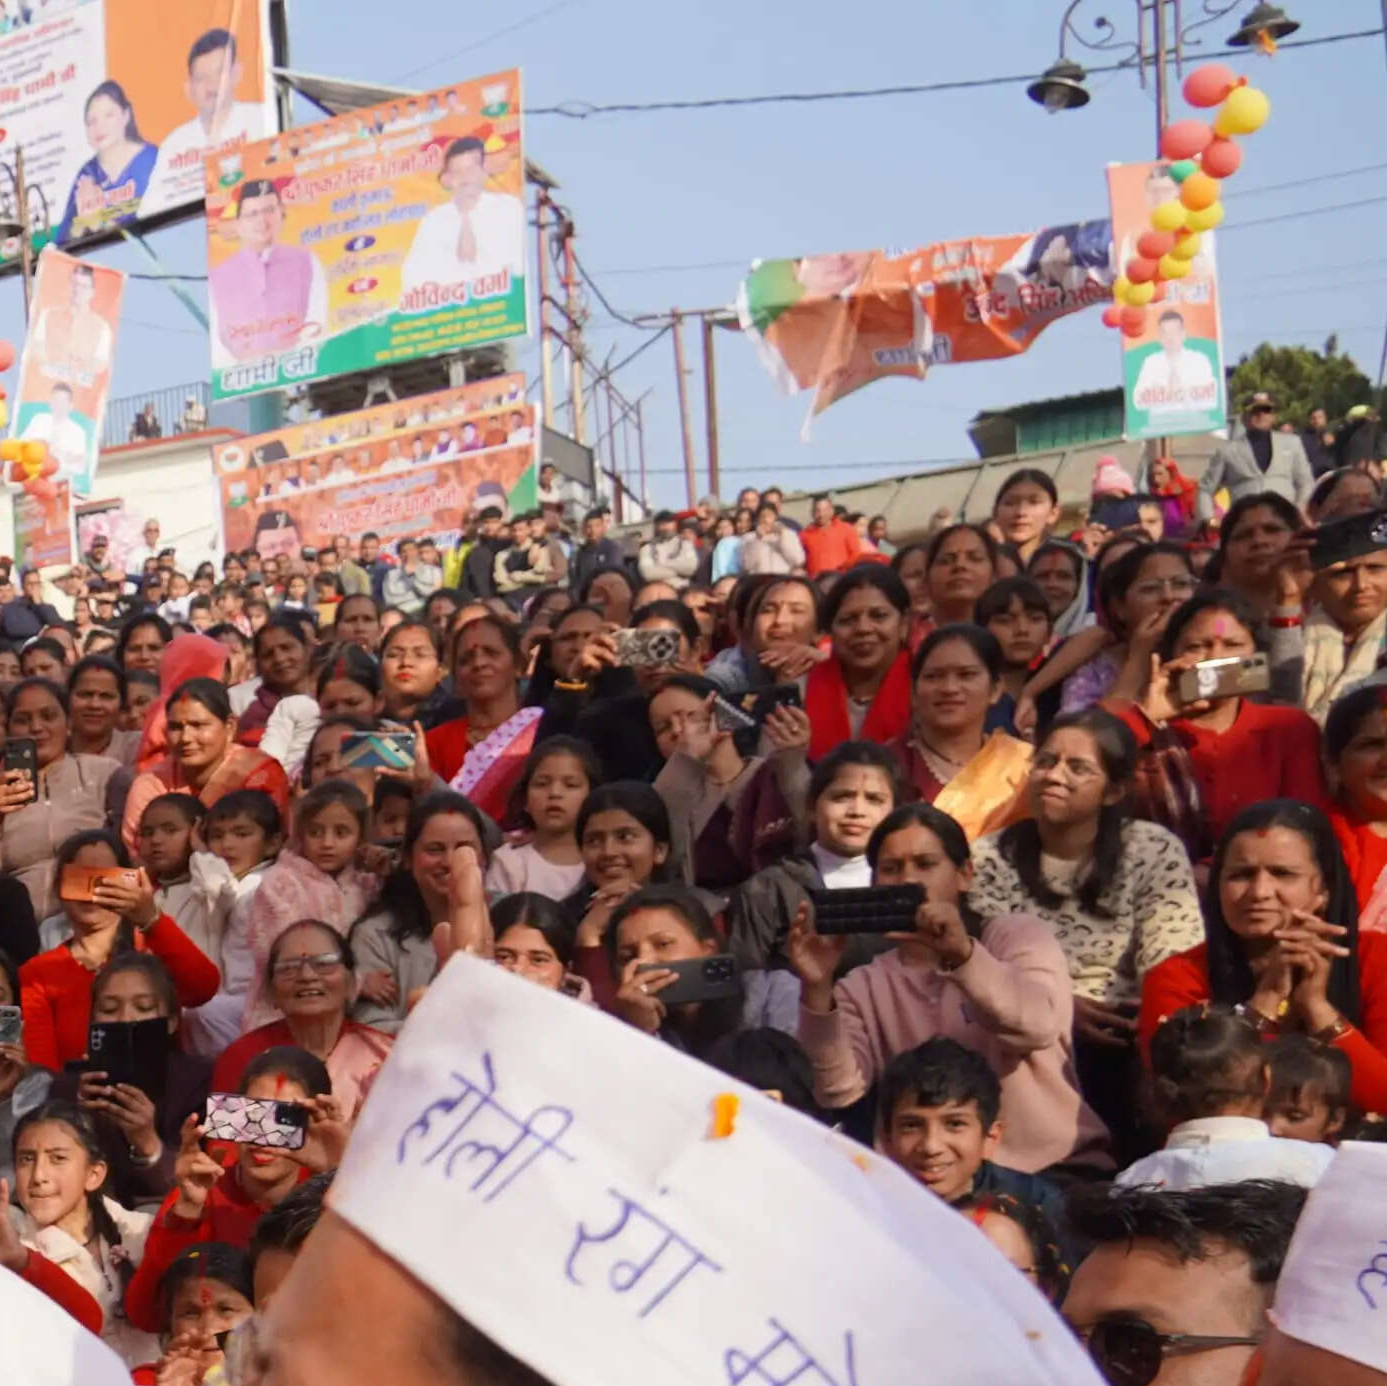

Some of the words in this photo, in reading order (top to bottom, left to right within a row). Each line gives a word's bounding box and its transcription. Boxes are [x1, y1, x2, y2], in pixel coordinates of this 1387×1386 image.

[399, 281, 466, 314] गोविन्द
[222, 356, 277, 389] धामी
[282, 345, 315, 377] जी
[396, 1051, 577, 1204] होली
